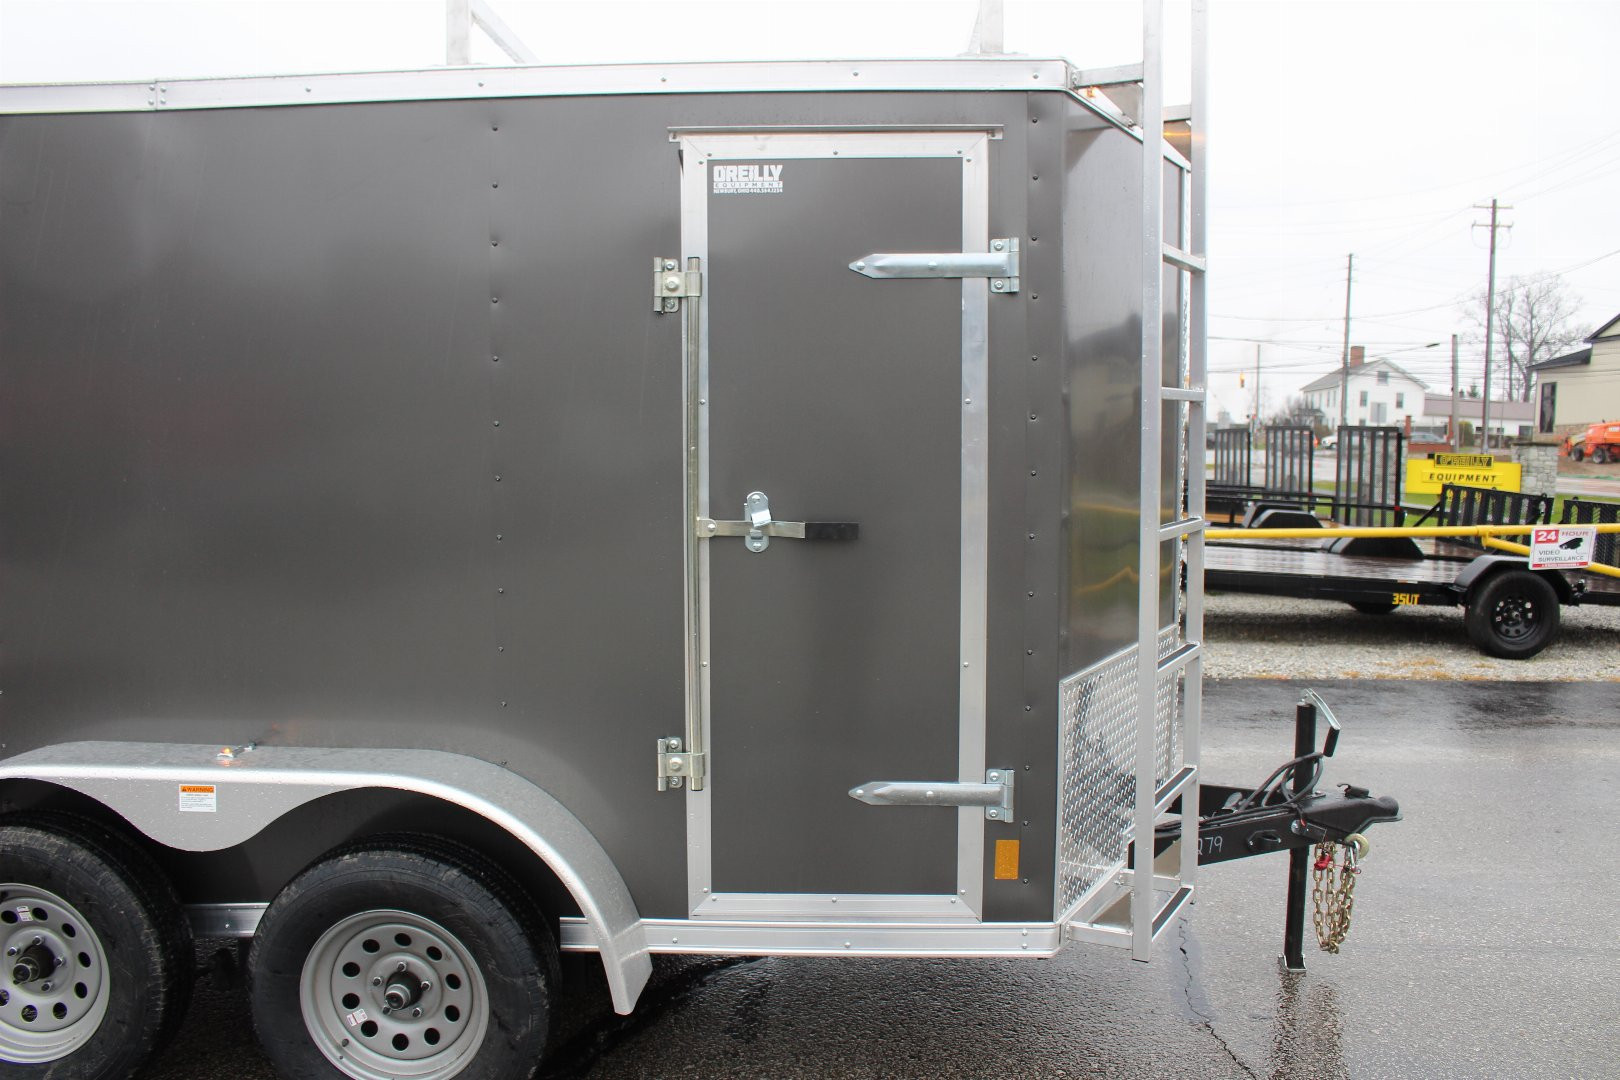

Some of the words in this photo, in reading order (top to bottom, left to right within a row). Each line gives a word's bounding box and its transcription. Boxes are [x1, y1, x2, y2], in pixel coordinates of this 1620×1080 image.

[1429, 473, 1496, 482] EQUIPMENT
[1537, 530, 1557, 542] 24
[1538, 555, 1584, 563] SURVEILLANCE
[1391, 592, 1420, 605] 35UT
